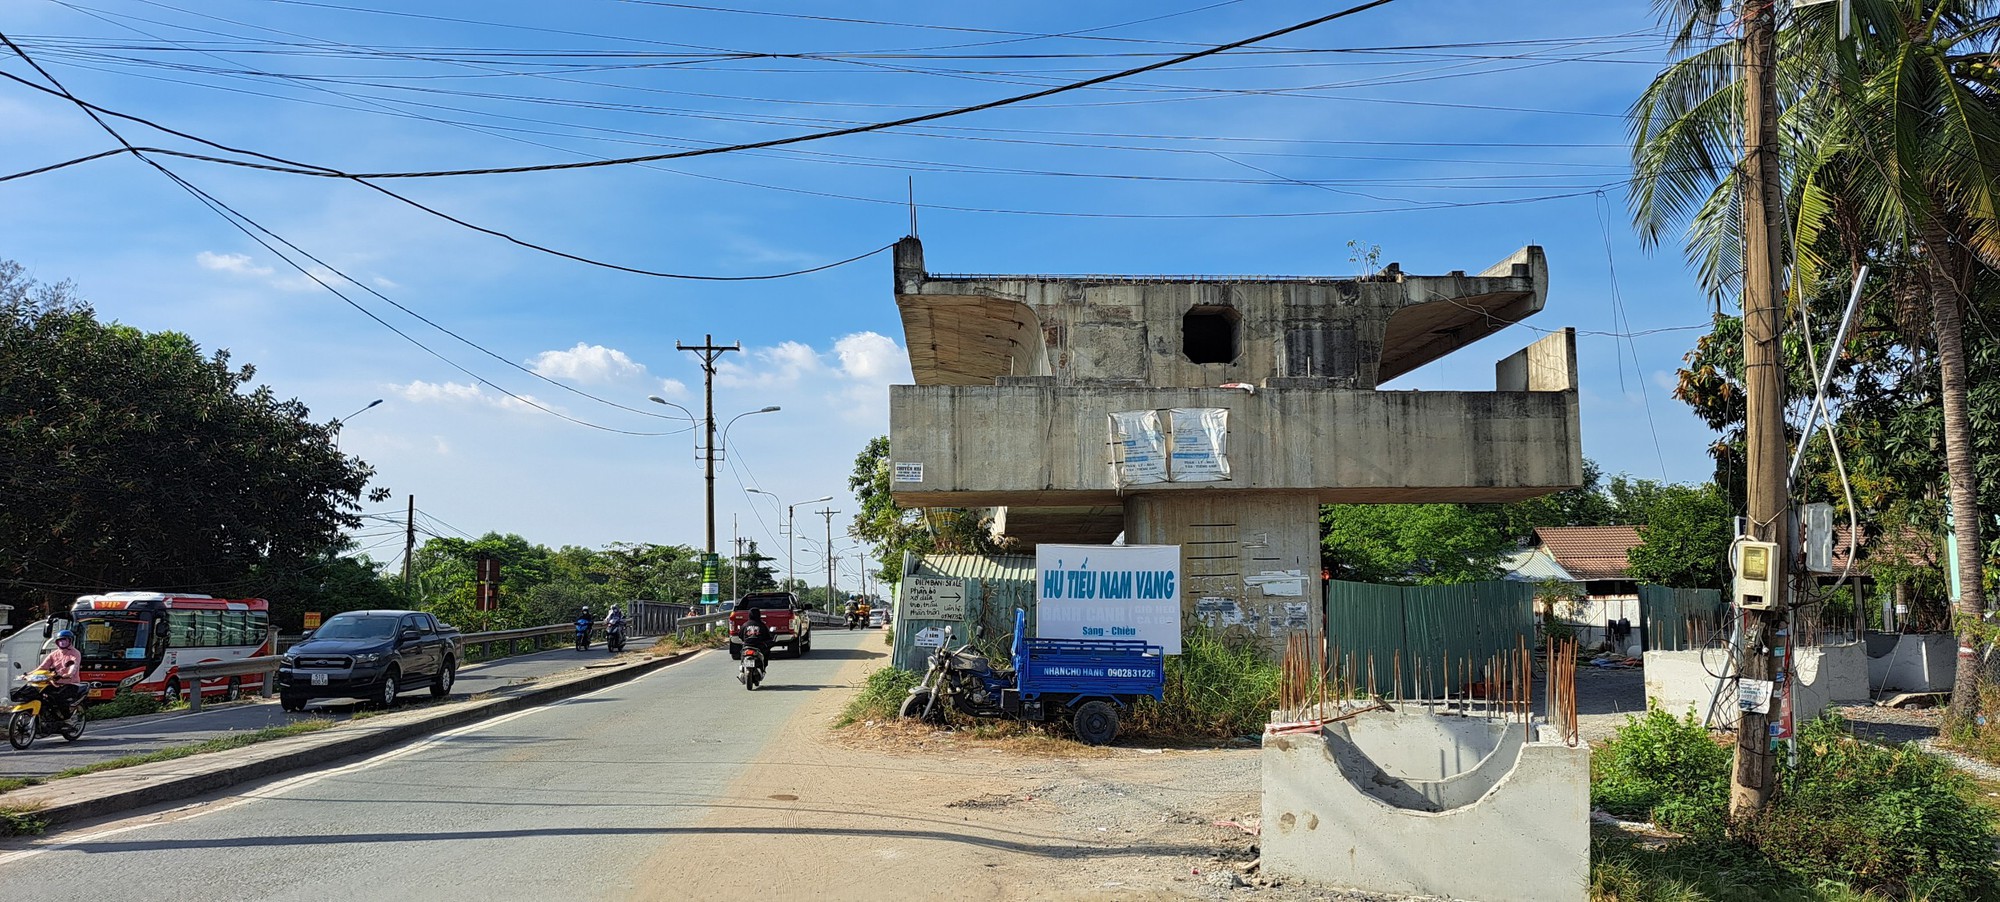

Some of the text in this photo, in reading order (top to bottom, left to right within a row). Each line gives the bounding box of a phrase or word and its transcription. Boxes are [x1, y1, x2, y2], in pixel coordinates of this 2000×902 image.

[1043, 557, 1175, 600] HỦ TIẾU NAM VANG
